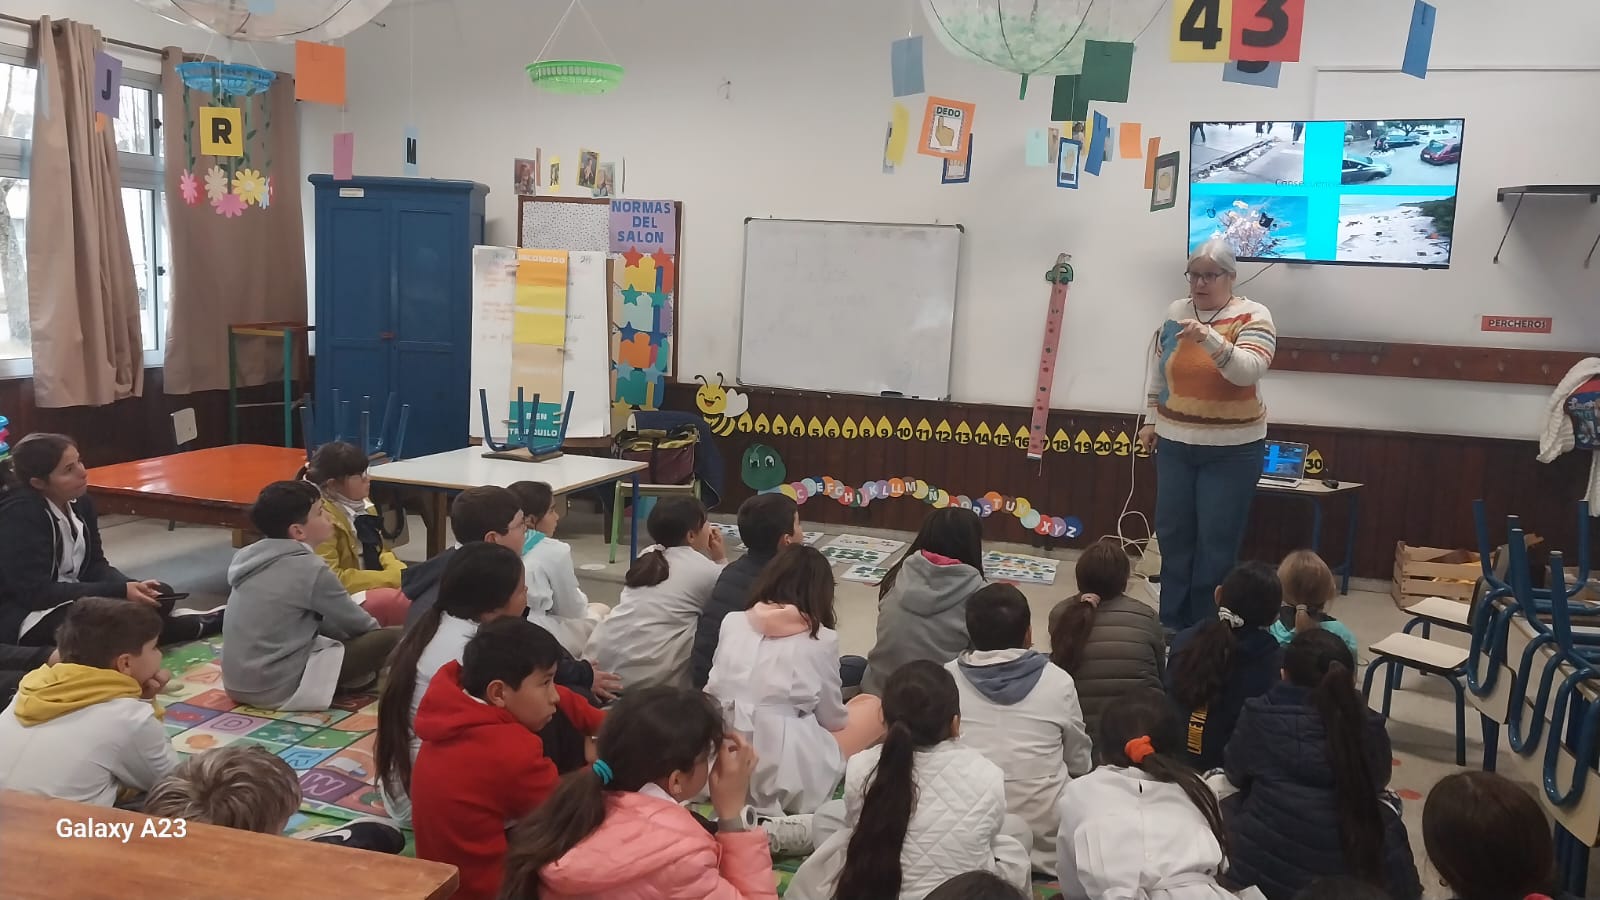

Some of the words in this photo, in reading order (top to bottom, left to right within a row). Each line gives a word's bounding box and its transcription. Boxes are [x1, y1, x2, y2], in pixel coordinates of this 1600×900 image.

[1180, 0, 1222, 49] 4
[1242, 0, 1288, 47] 3
[102, 69, 112, 100] J
[937, 107, 960, 117] DEDO
[211, 117, 232, 144] R
[612, 201, 670, 213] NORMAS
[632, 216, 657, 228] DEL
[617, 231, 663, 243] SALON
[526, 412, 547, 420] BEN
[741, 422, 748, 433] 1
[758, 424, 766, 433] 2
[776, 427, 784, 435] 3
[792, 427, 801, 437] 4
[812, 429, 819, 438] 5
[828, 429, 836, 438] 6
[846, 429, 854, 439] 7
[863, 429, 871, 438] 8
[880, 429, 888, 438] 9
[898, 428, 911, 438] 10
[917, 429, 930, 439] 11
[936, 430, 950, 441] 12
[956, 432, 970, 442] 13
[975, 433, 989, 443] 14
[995, 434, 1009, 444] 15
[1016, 437, 1029, 447] 16
[1054, 440, 1068, 450] 18
[1075, 441, 1091, 452] 19
[1095, 441, 1111, 452] 20
[1115, 442, 1130, 452] 21
[1305, 459, 1322, 469] 30
[816, 482, 823, 492] E
[845, 491, 853, 502] H
[869, 486, 878, 495] K
[882, 486, 888, 496] L
[906, 482, 916, 492] M
[983, 504, 991, 514] S
[993, 498, 1000, 508] T
[1005, 501, 1015, 511] U
[1041, 521, 1051, 532] X
[1053, 524, 1062, 535] Y
[1066, 526, 1076, 537] Z
